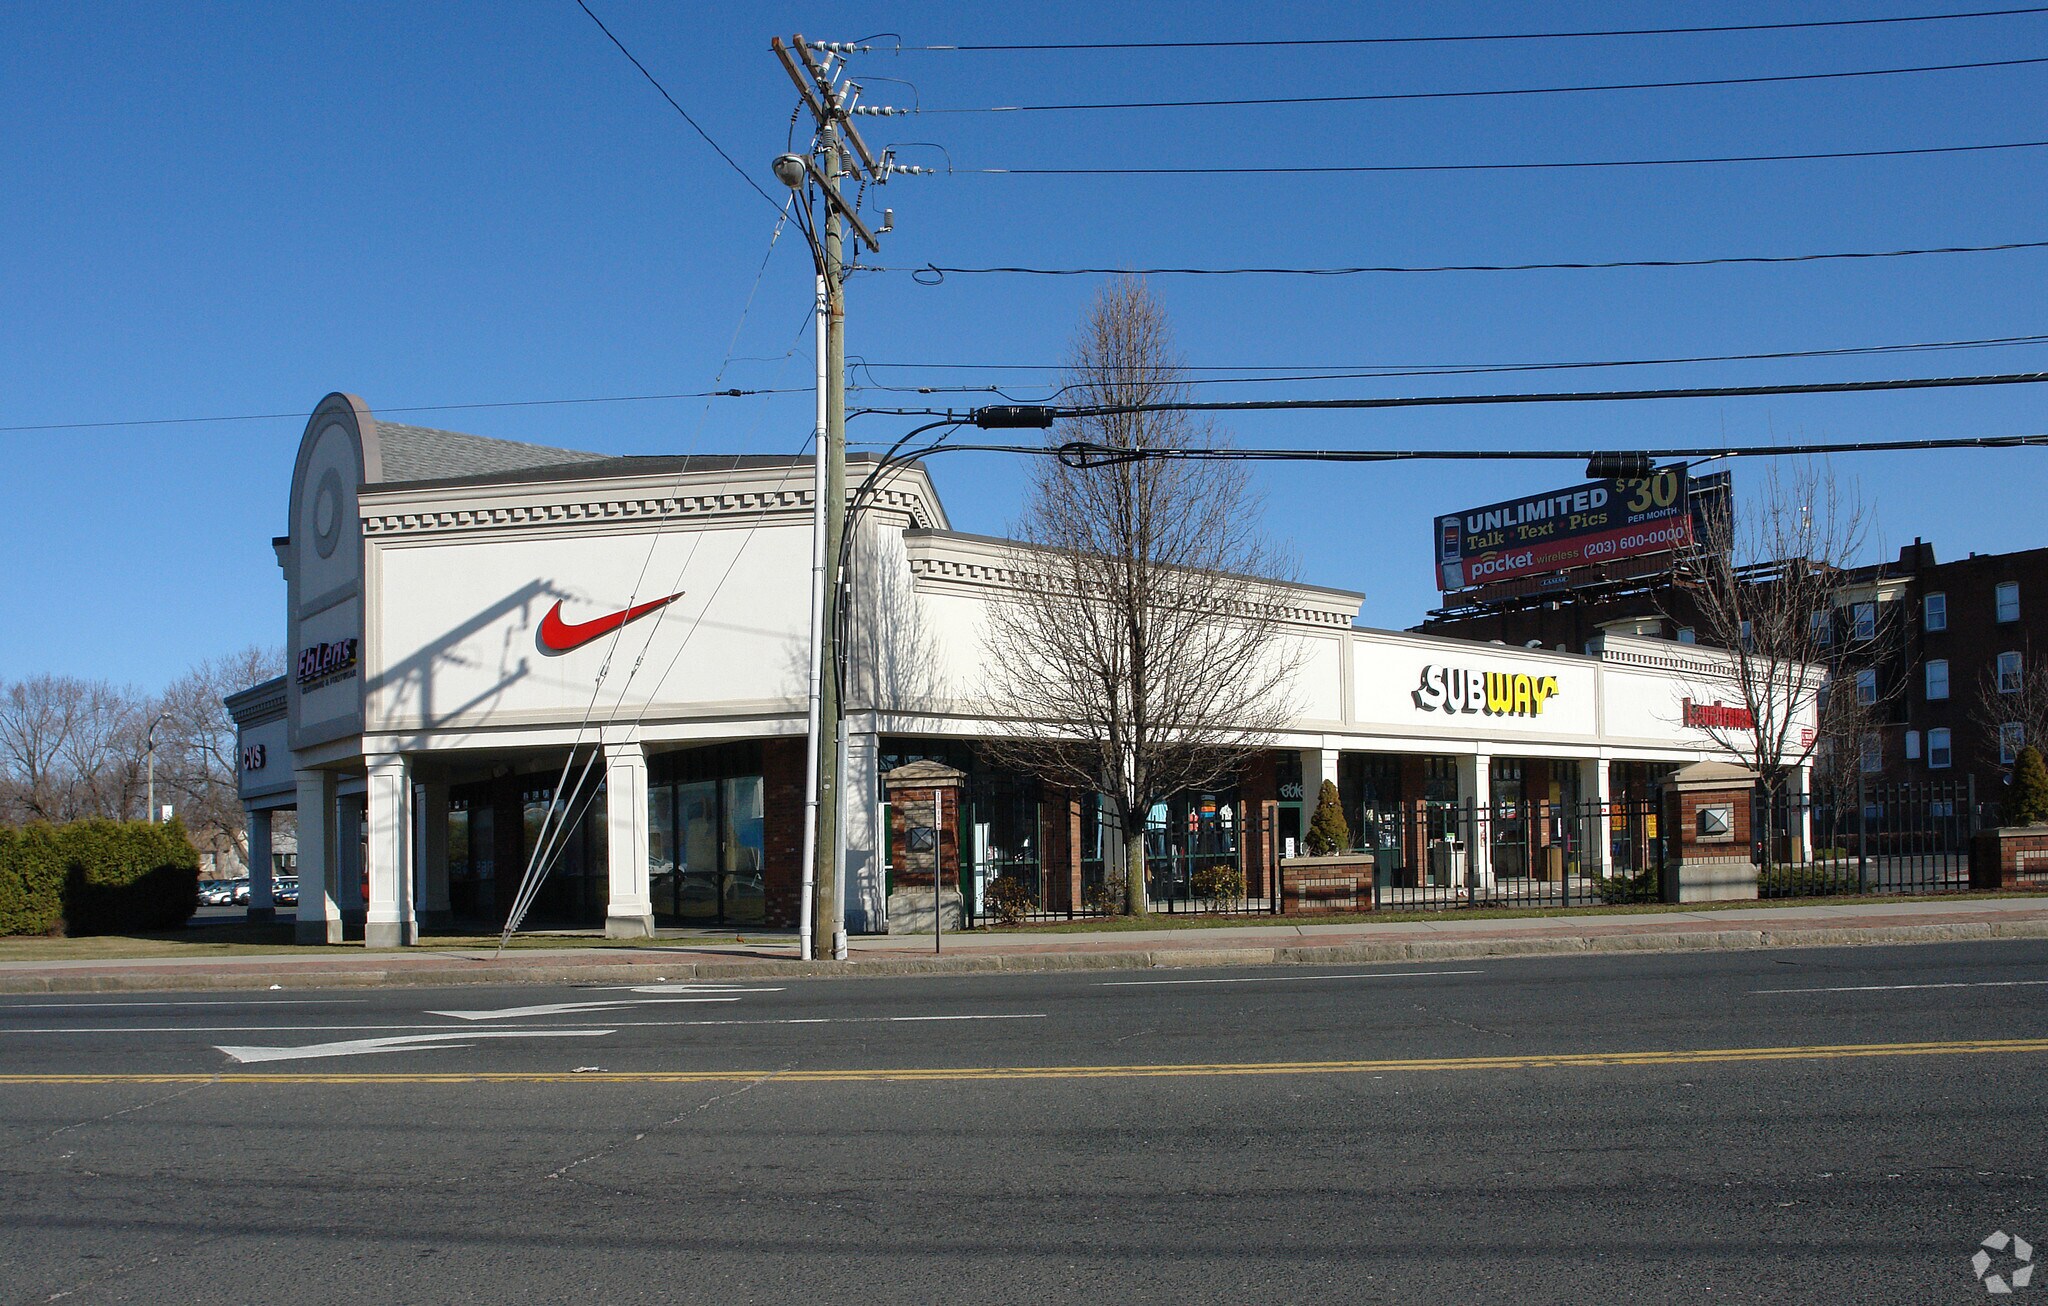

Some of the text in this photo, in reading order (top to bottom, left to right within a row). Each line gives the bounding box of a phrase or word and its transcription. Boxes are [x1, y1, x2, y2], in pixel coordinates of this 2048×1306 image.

[1467, 488, 1608, 534] UNLIMITED
[1467, 531, 1505, 550] Talk
[1518, 521, 1554, 540] Text
[1569, 512, 1608, 531] Pics
[1628, 507, 1677, 524] PER MONTH
[1471, 527, 1684, 580] pocket wireless (203) 600-0000
[297, 638, 356, 680] EbLens
[1412, 664, 1559, 716] SUBWAY
[242, 744, 264, 770] CVS
